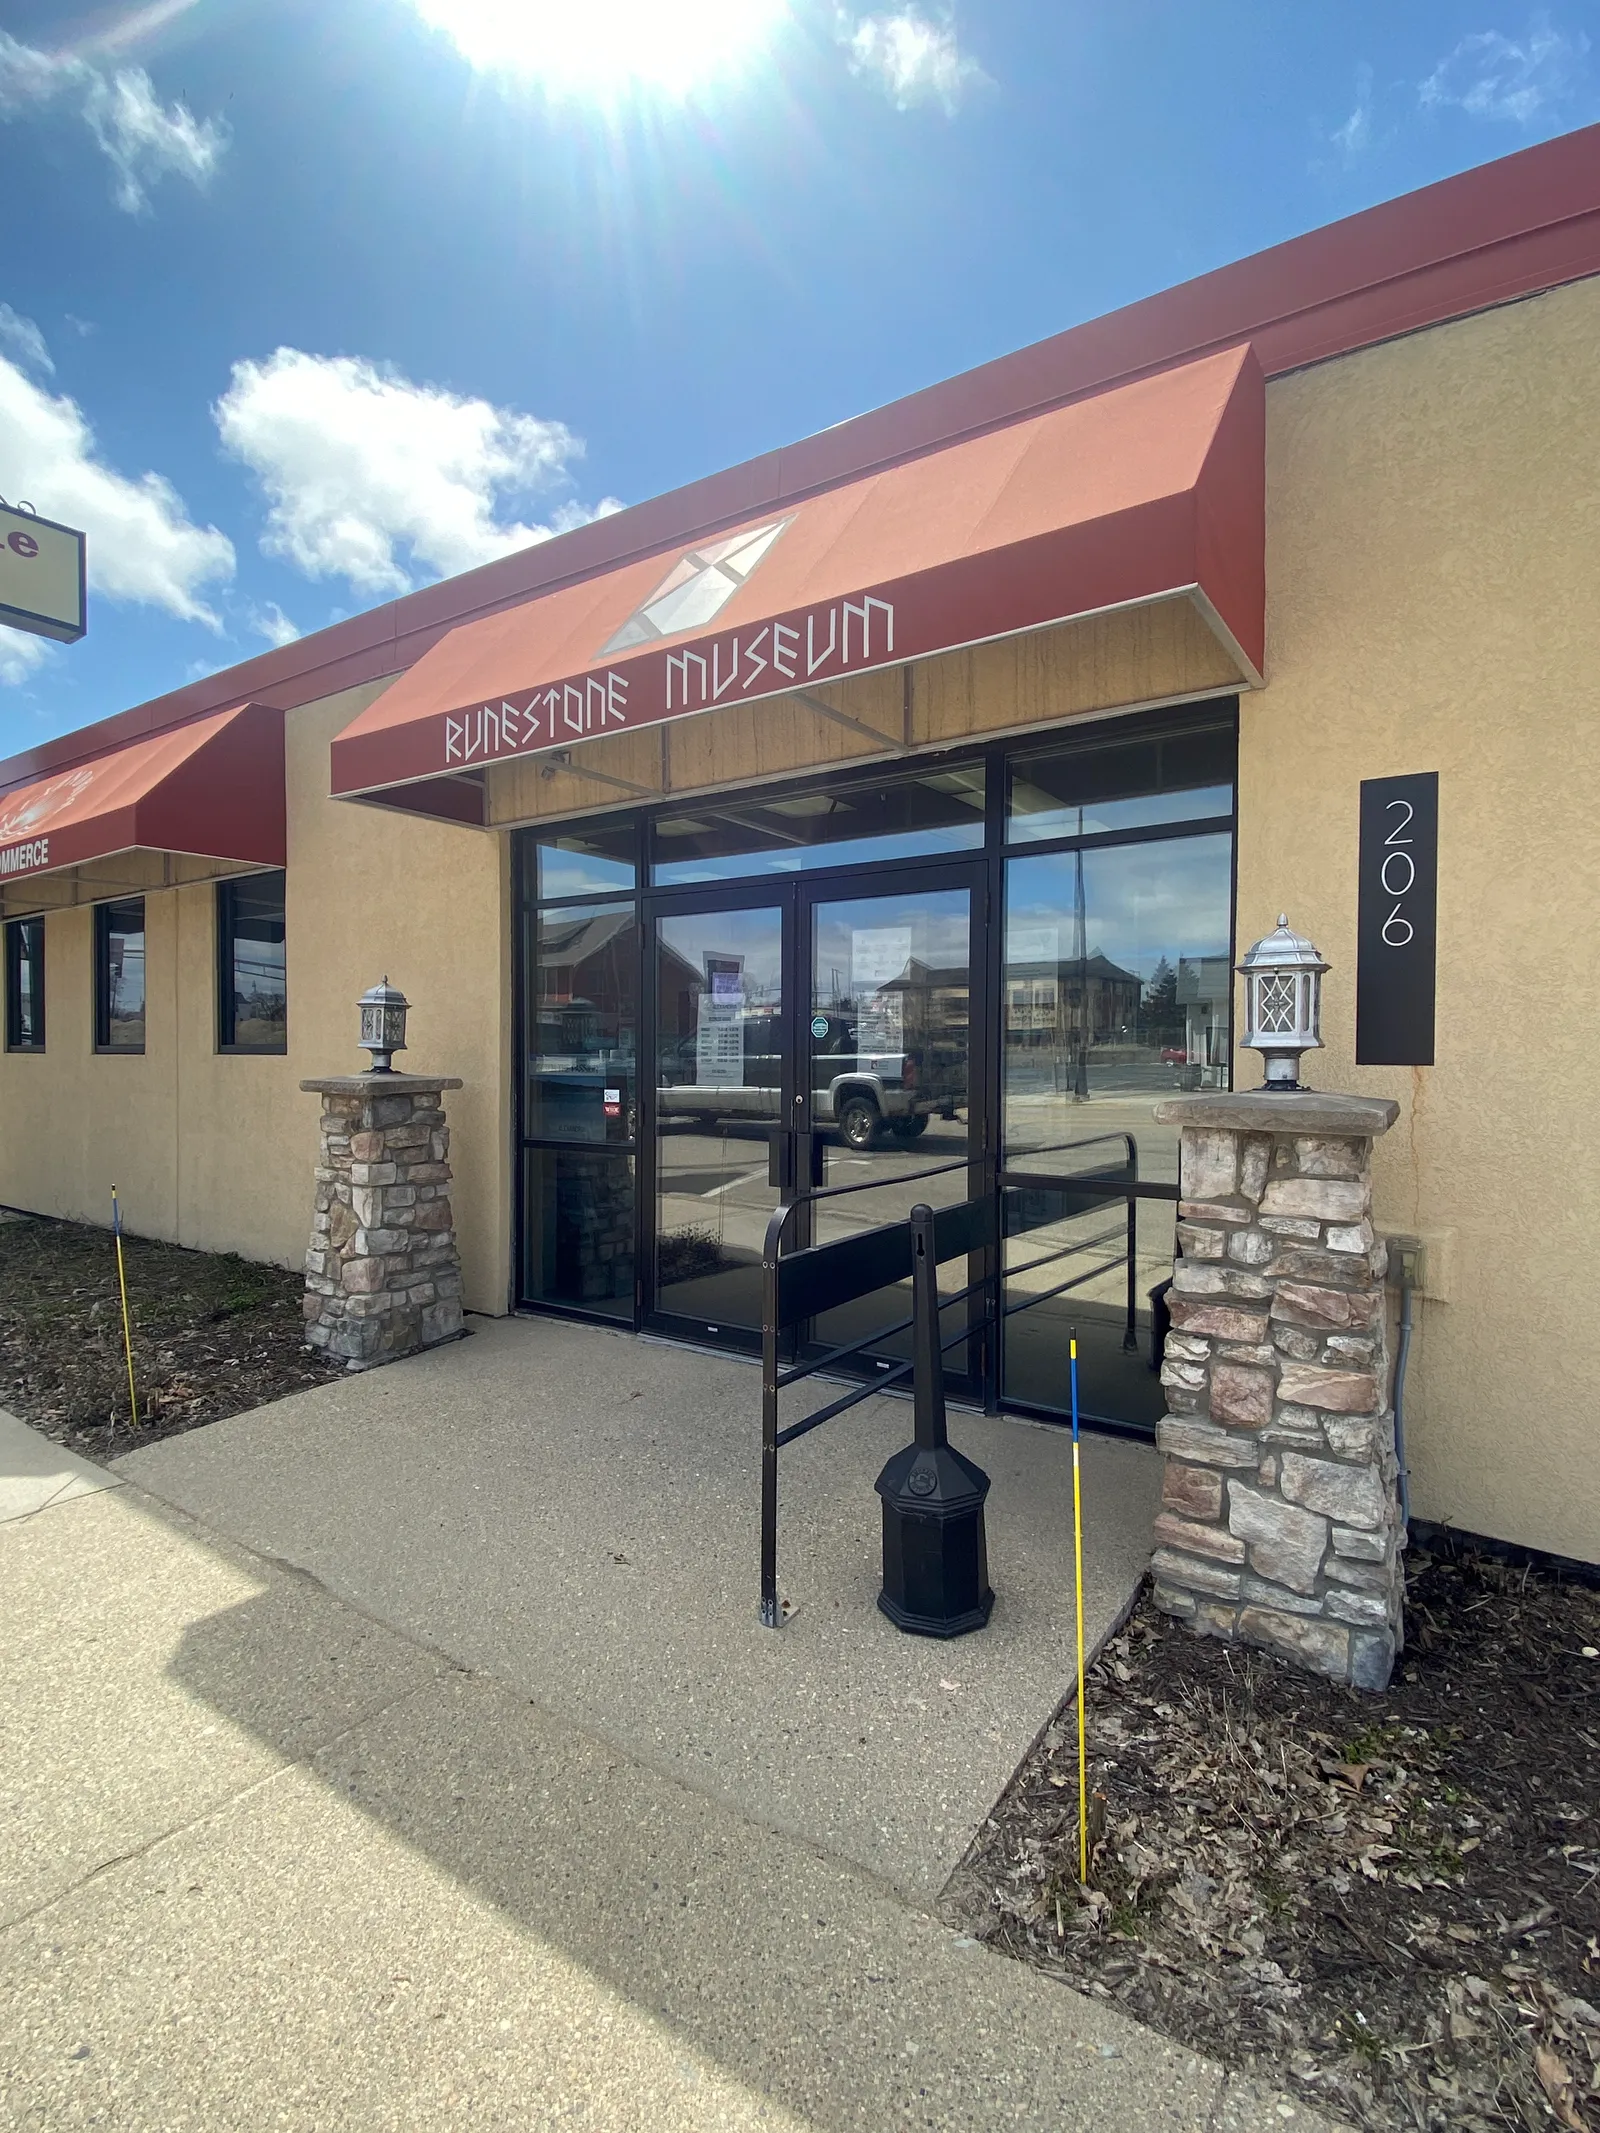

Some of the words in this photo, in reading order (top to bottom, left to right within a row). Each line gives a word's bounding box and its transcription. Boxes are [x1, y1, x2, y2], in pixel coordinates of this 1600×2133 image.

[0, 531, 39, 558] e
[445, 671, 630, 763] RUNESTONE
[666, 595, 895, 710] MUSEUM
[0, 838, 49, 875] MMERCE
[1381, 800, 1415, 947] 206
